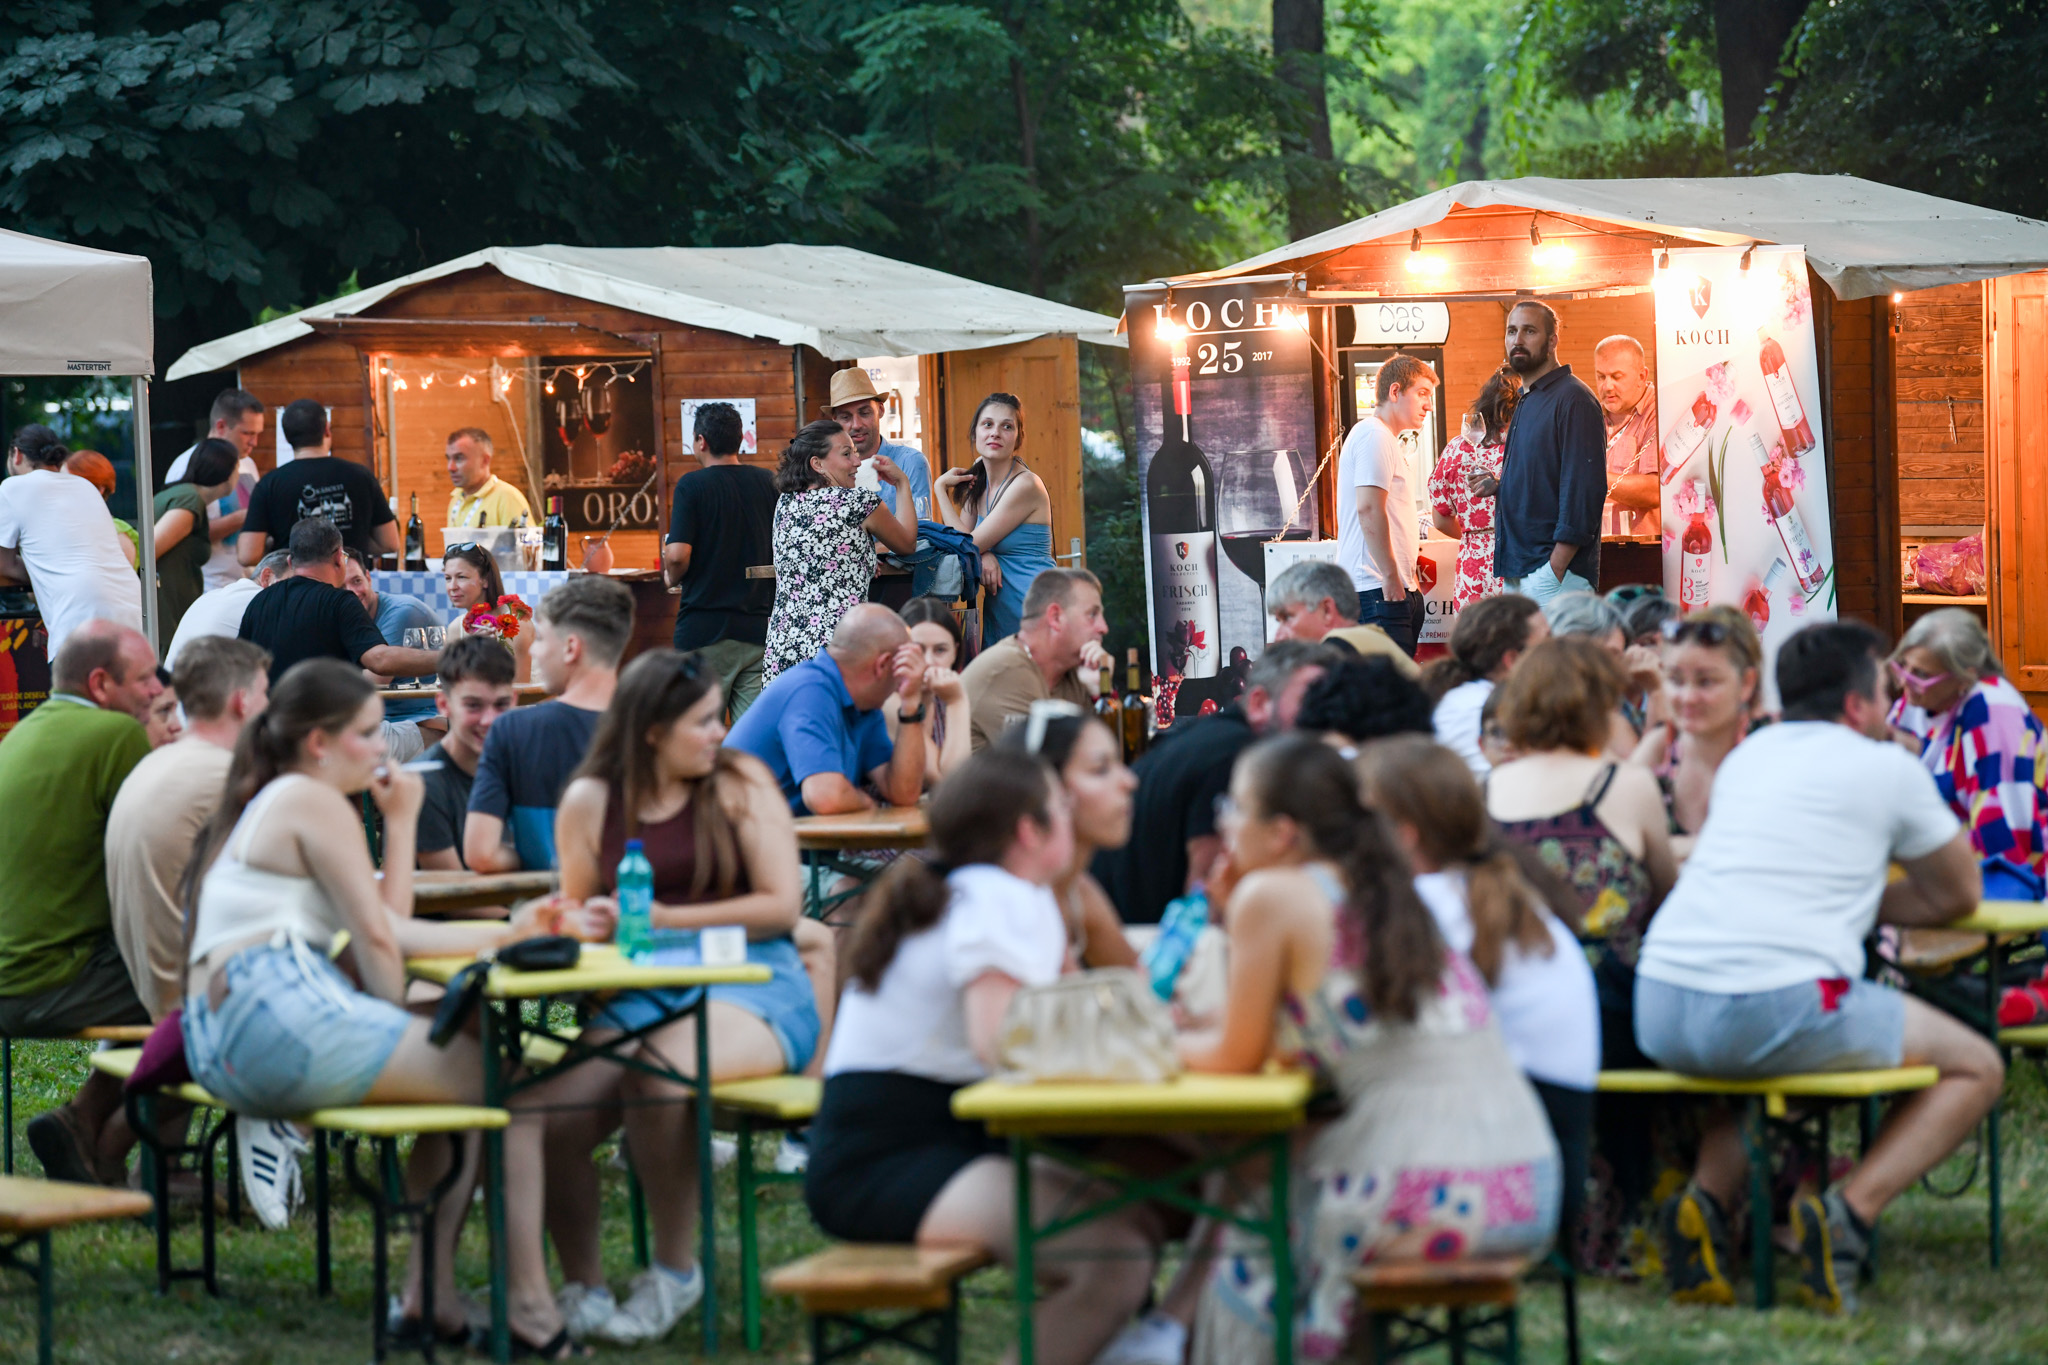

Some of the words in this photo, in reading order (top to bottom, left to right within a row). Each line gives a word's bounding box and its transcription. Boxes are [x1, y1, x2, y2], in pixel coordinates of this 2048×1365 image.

[1153, 299, 1279, 332] KOCH
[1675, 328, 1730, 345] KOCH
[1172, 357, 1191, 366] 1992
[1197, 341, 1244, 374] 25
[1252, 351, 1273, 362] 2017
[67, 363, 111, 371] MASTERTENT
[583, 491, 659, 525] ORO
[1169, 563, 1198, 572] KOCH
[1162, 583, 1208, 599] FRISCH
[1425, 600, 1453, 616] CH
[1426, 627, 1451, 639] PRÉMIU
